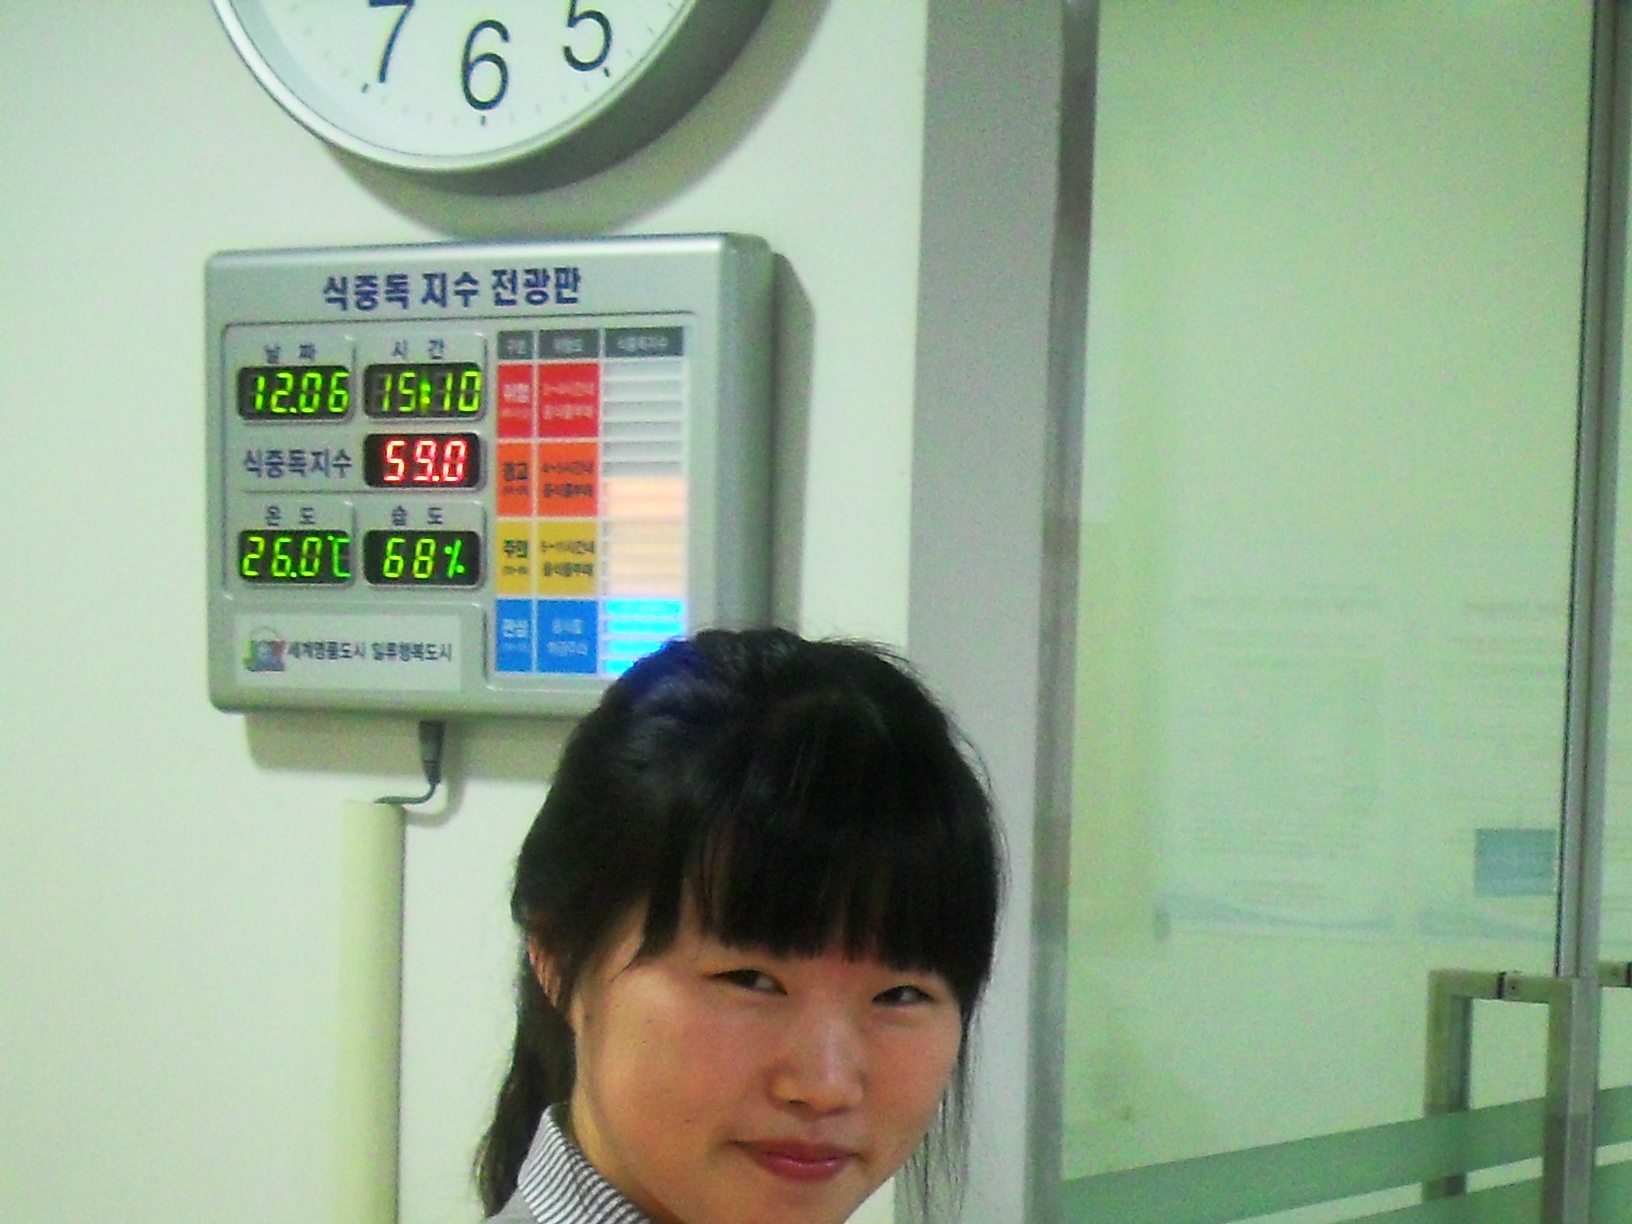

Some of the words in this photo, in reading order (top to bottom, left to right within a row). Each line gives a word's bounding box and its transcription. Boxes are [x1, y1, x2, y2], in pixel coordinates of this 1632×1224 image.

[562, 0, 613, 72] 5
[460, 19, 510, 111] 6
[323, 272, 410, 311] 식중독
[421, 270, 480, 309] 지수
[491, 266, 582, 307] 전광판
[253, 371, 350, 414] 12.06
[381, 370, 483, 413] 15:10
[244, 448, 352, 479] 식중독지수
[382, 439, 467, 482] 59.0
